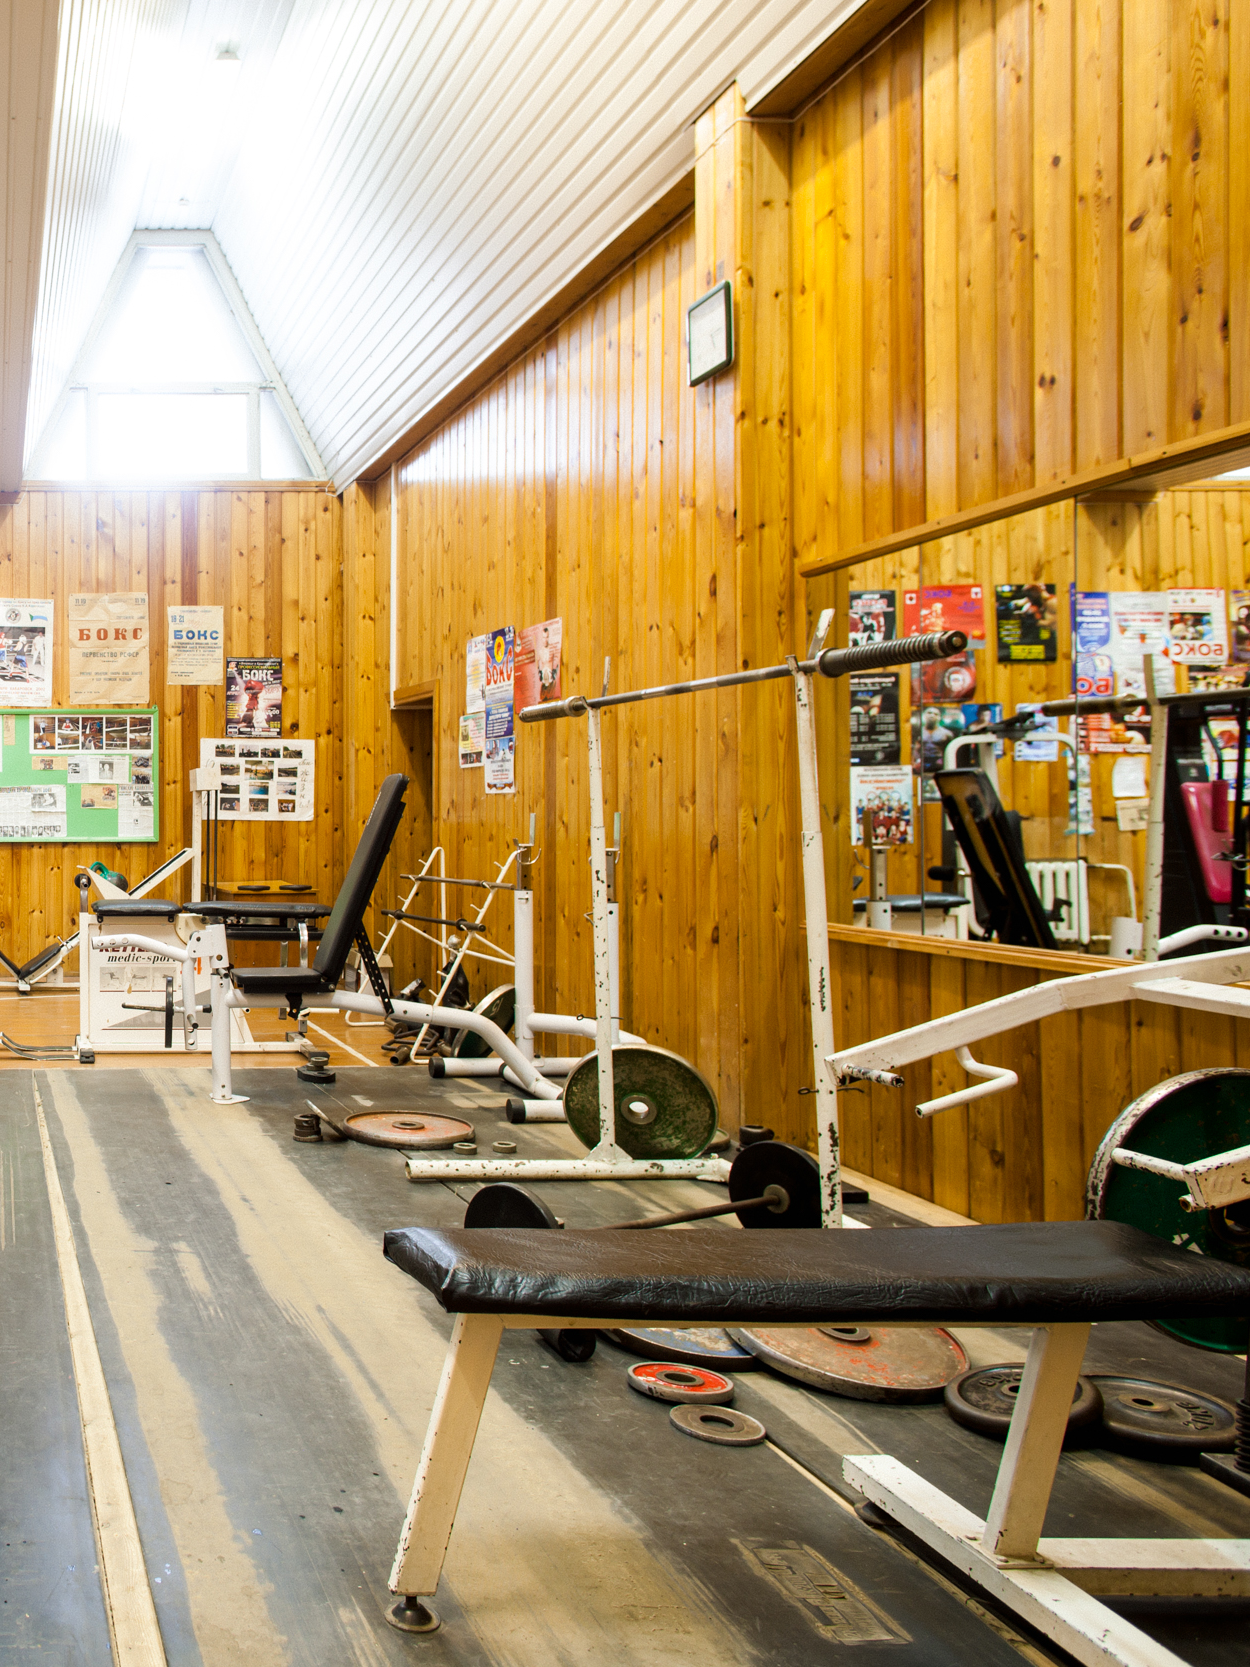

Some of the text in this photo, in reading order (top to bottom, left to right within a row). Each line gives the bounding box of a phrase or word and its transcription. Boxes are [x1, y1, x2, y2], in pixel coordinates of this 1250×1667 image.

[78, 628, 143, 641] БОКС
[174, 630, 219, 640] БОКС
[486, 645, 513, 686] БОКС
[242, 670, 274, 681] БОКС
